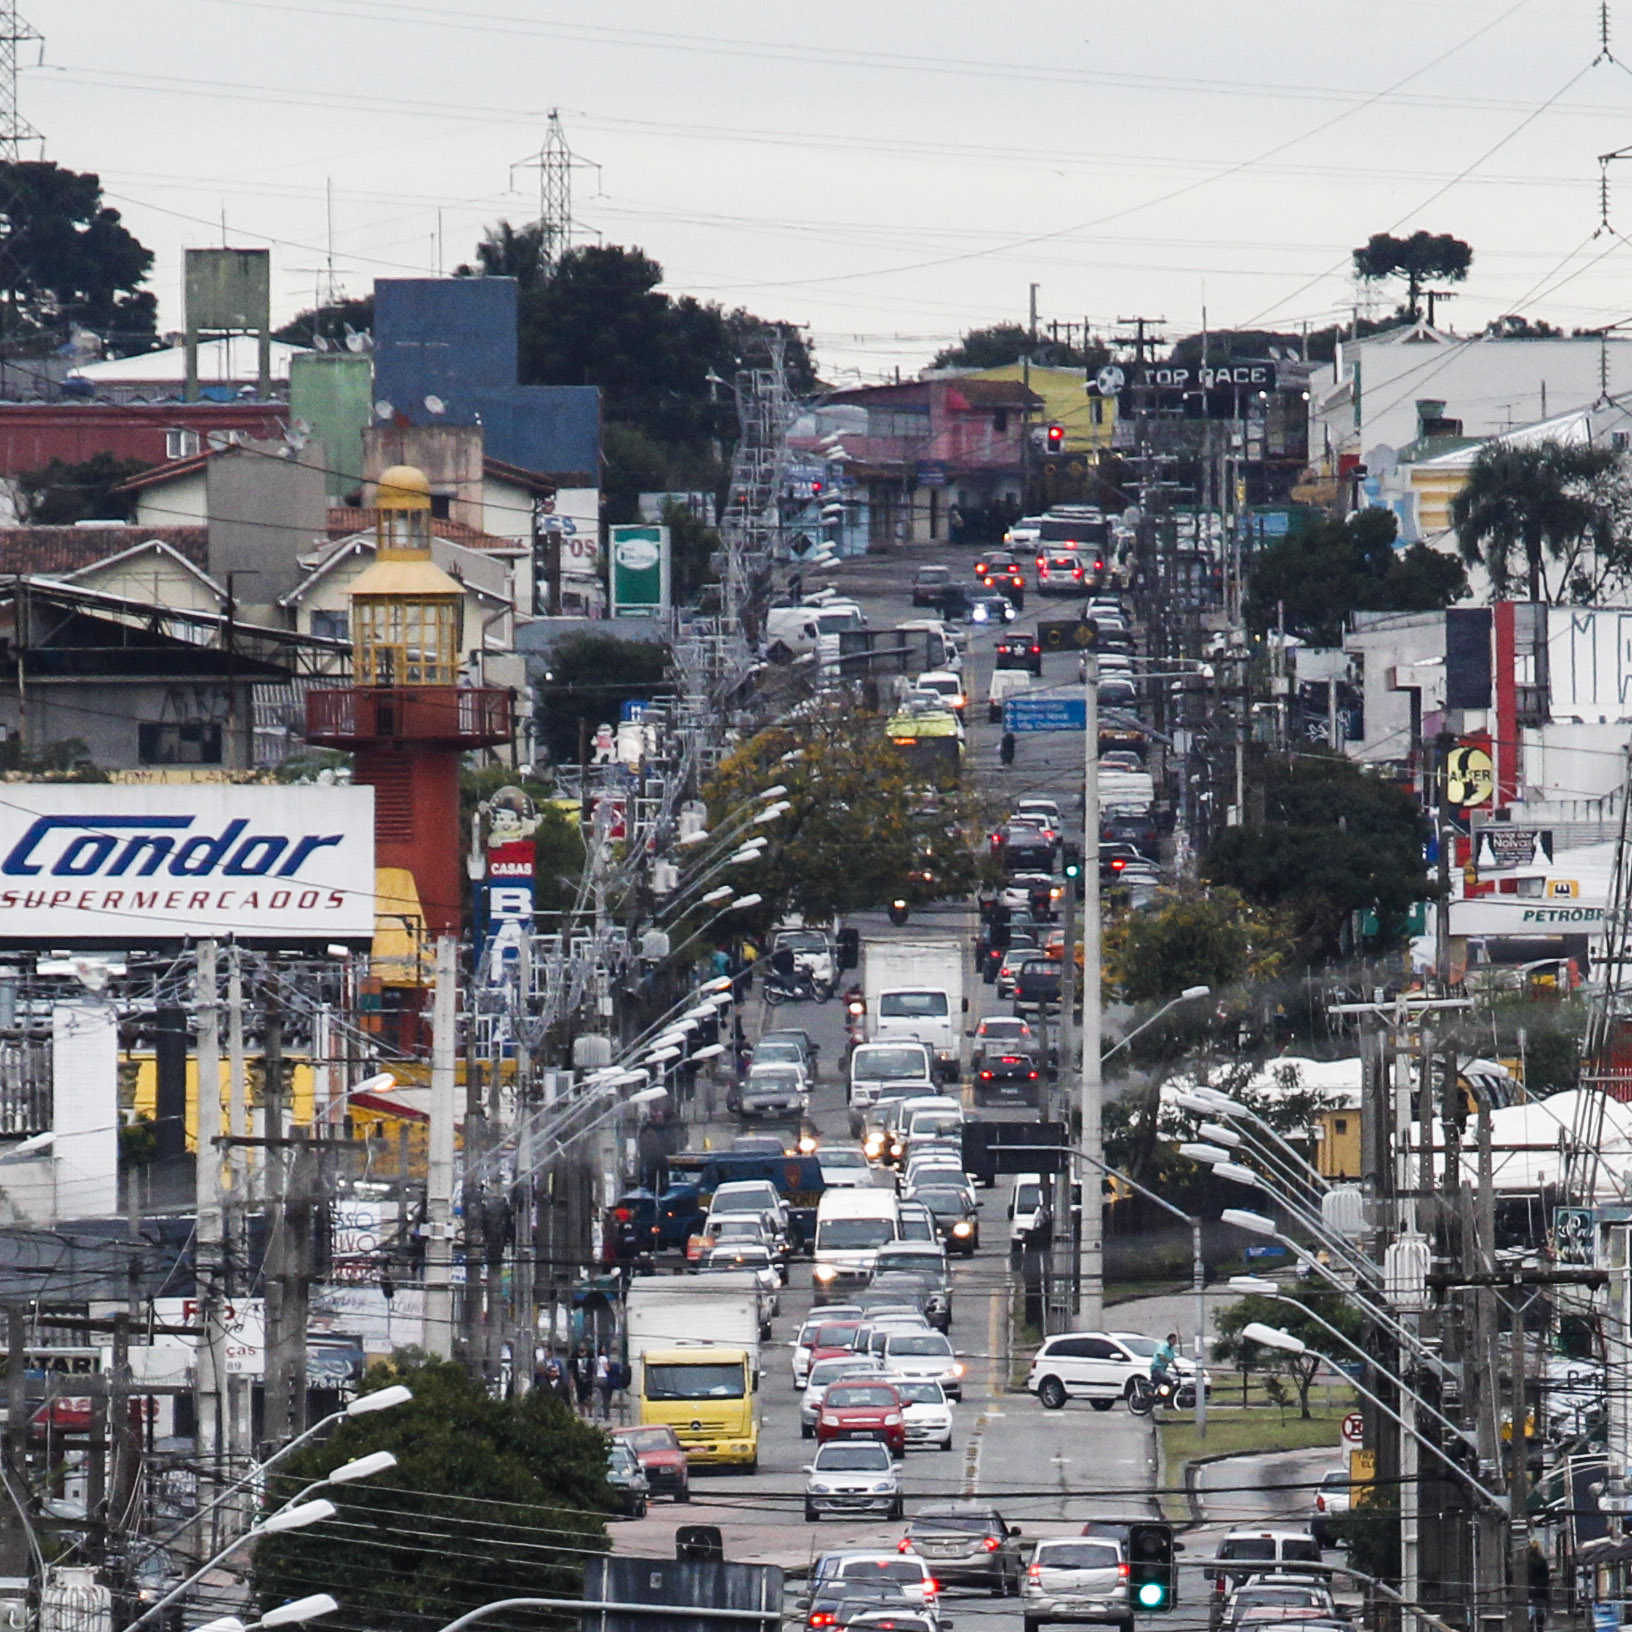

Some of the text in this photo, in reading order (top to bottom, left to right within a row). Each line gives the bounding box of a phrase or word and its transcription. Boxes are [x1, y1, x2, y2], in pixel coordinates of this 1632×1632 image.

[1144, 368, 1194, 386] TOP
[0, 813, 346, 877] Condor
[490, 862, 533, 876] CASAS
